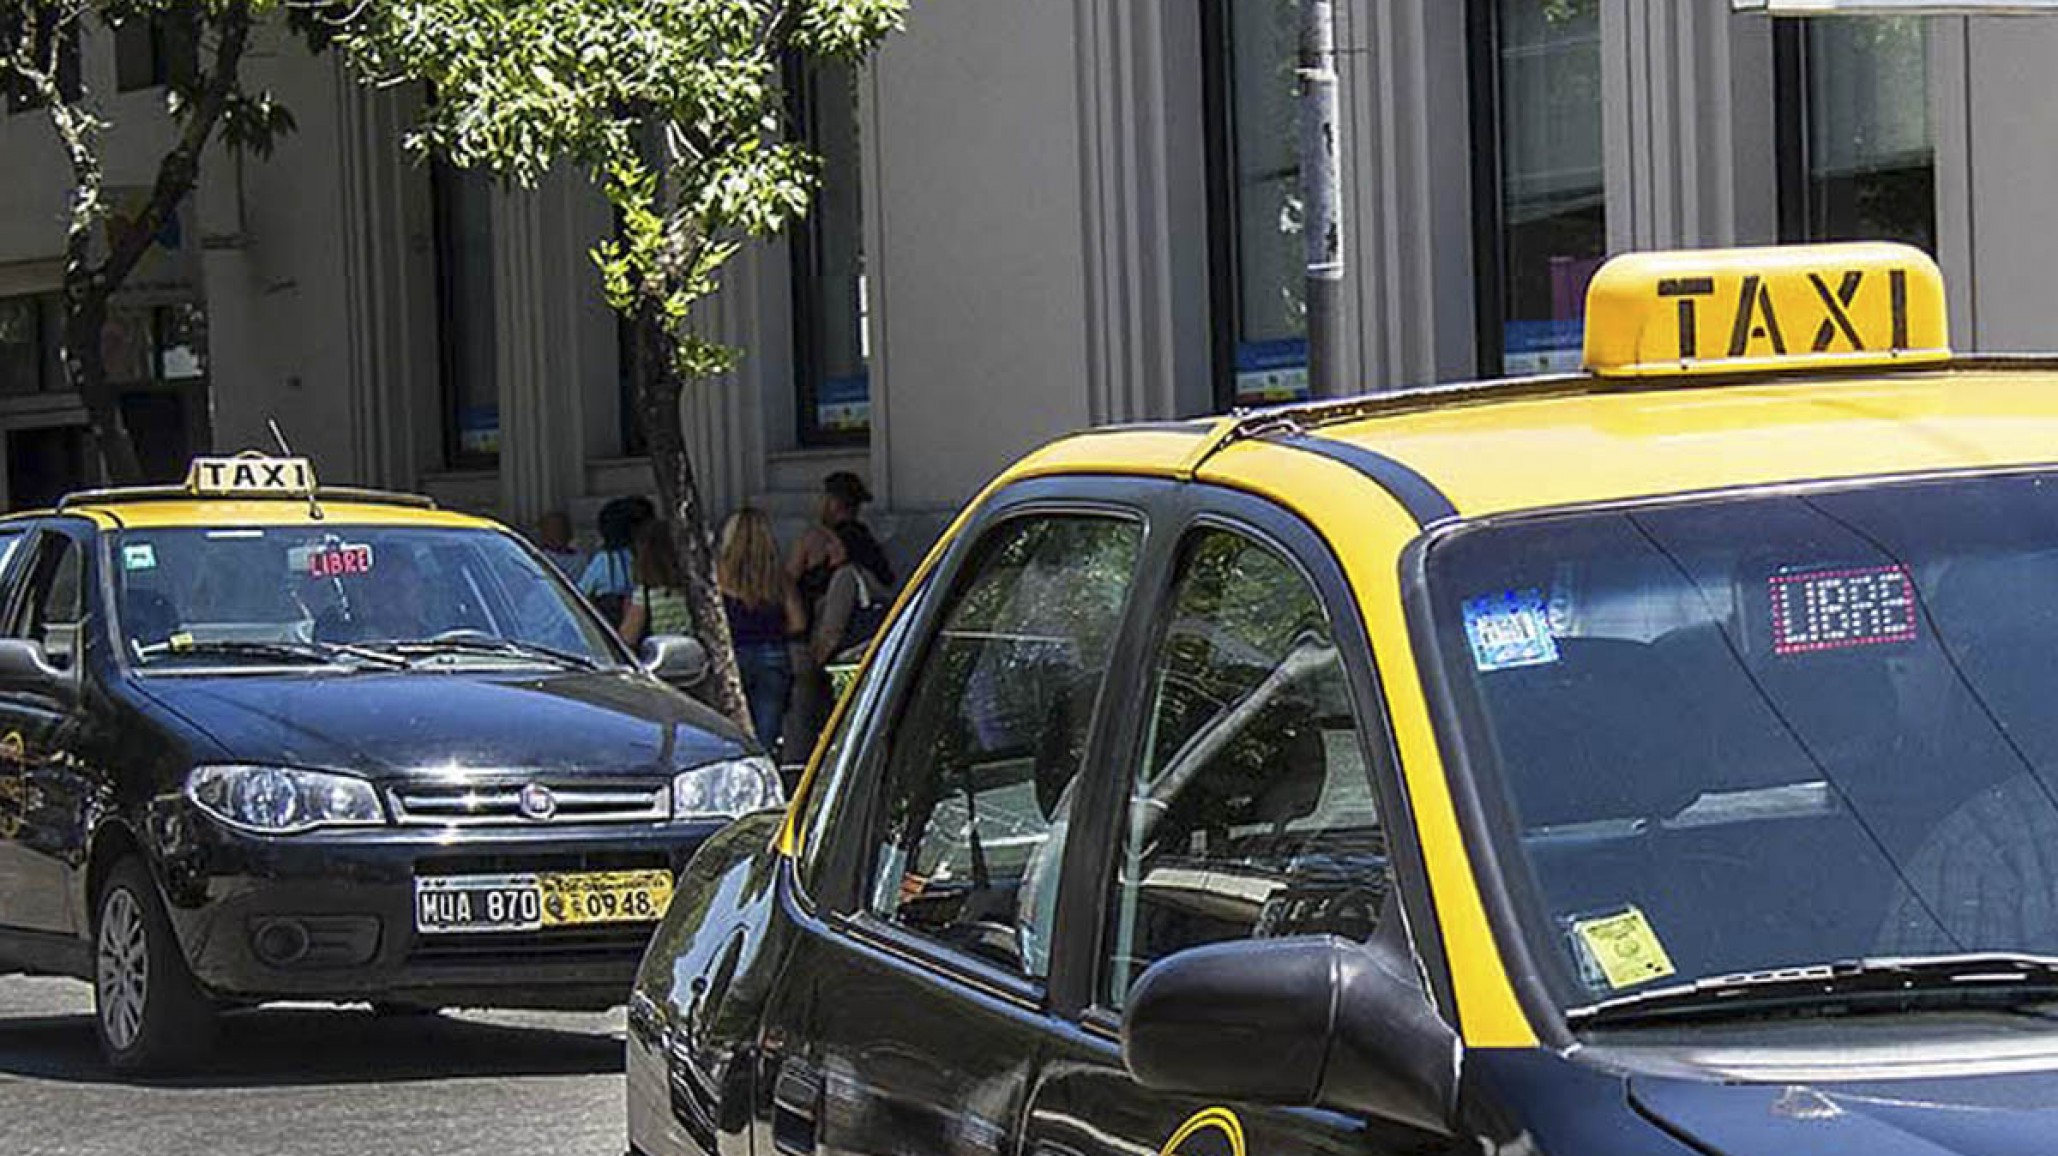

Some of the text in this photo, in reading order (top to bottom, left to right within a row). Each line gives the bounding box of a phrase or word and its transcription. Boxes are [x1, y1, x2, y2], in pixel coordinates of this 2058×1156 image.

[1657, 268, 1908, 358] TAXI
[203, 463, 305, 486] TAXI
[310, 548, 369, 576] LIBRE
[1779, 573, 1908, 643] LIBRE
[422, 892, 471, 921] MUA
[487, 891, 537, 920] 870
